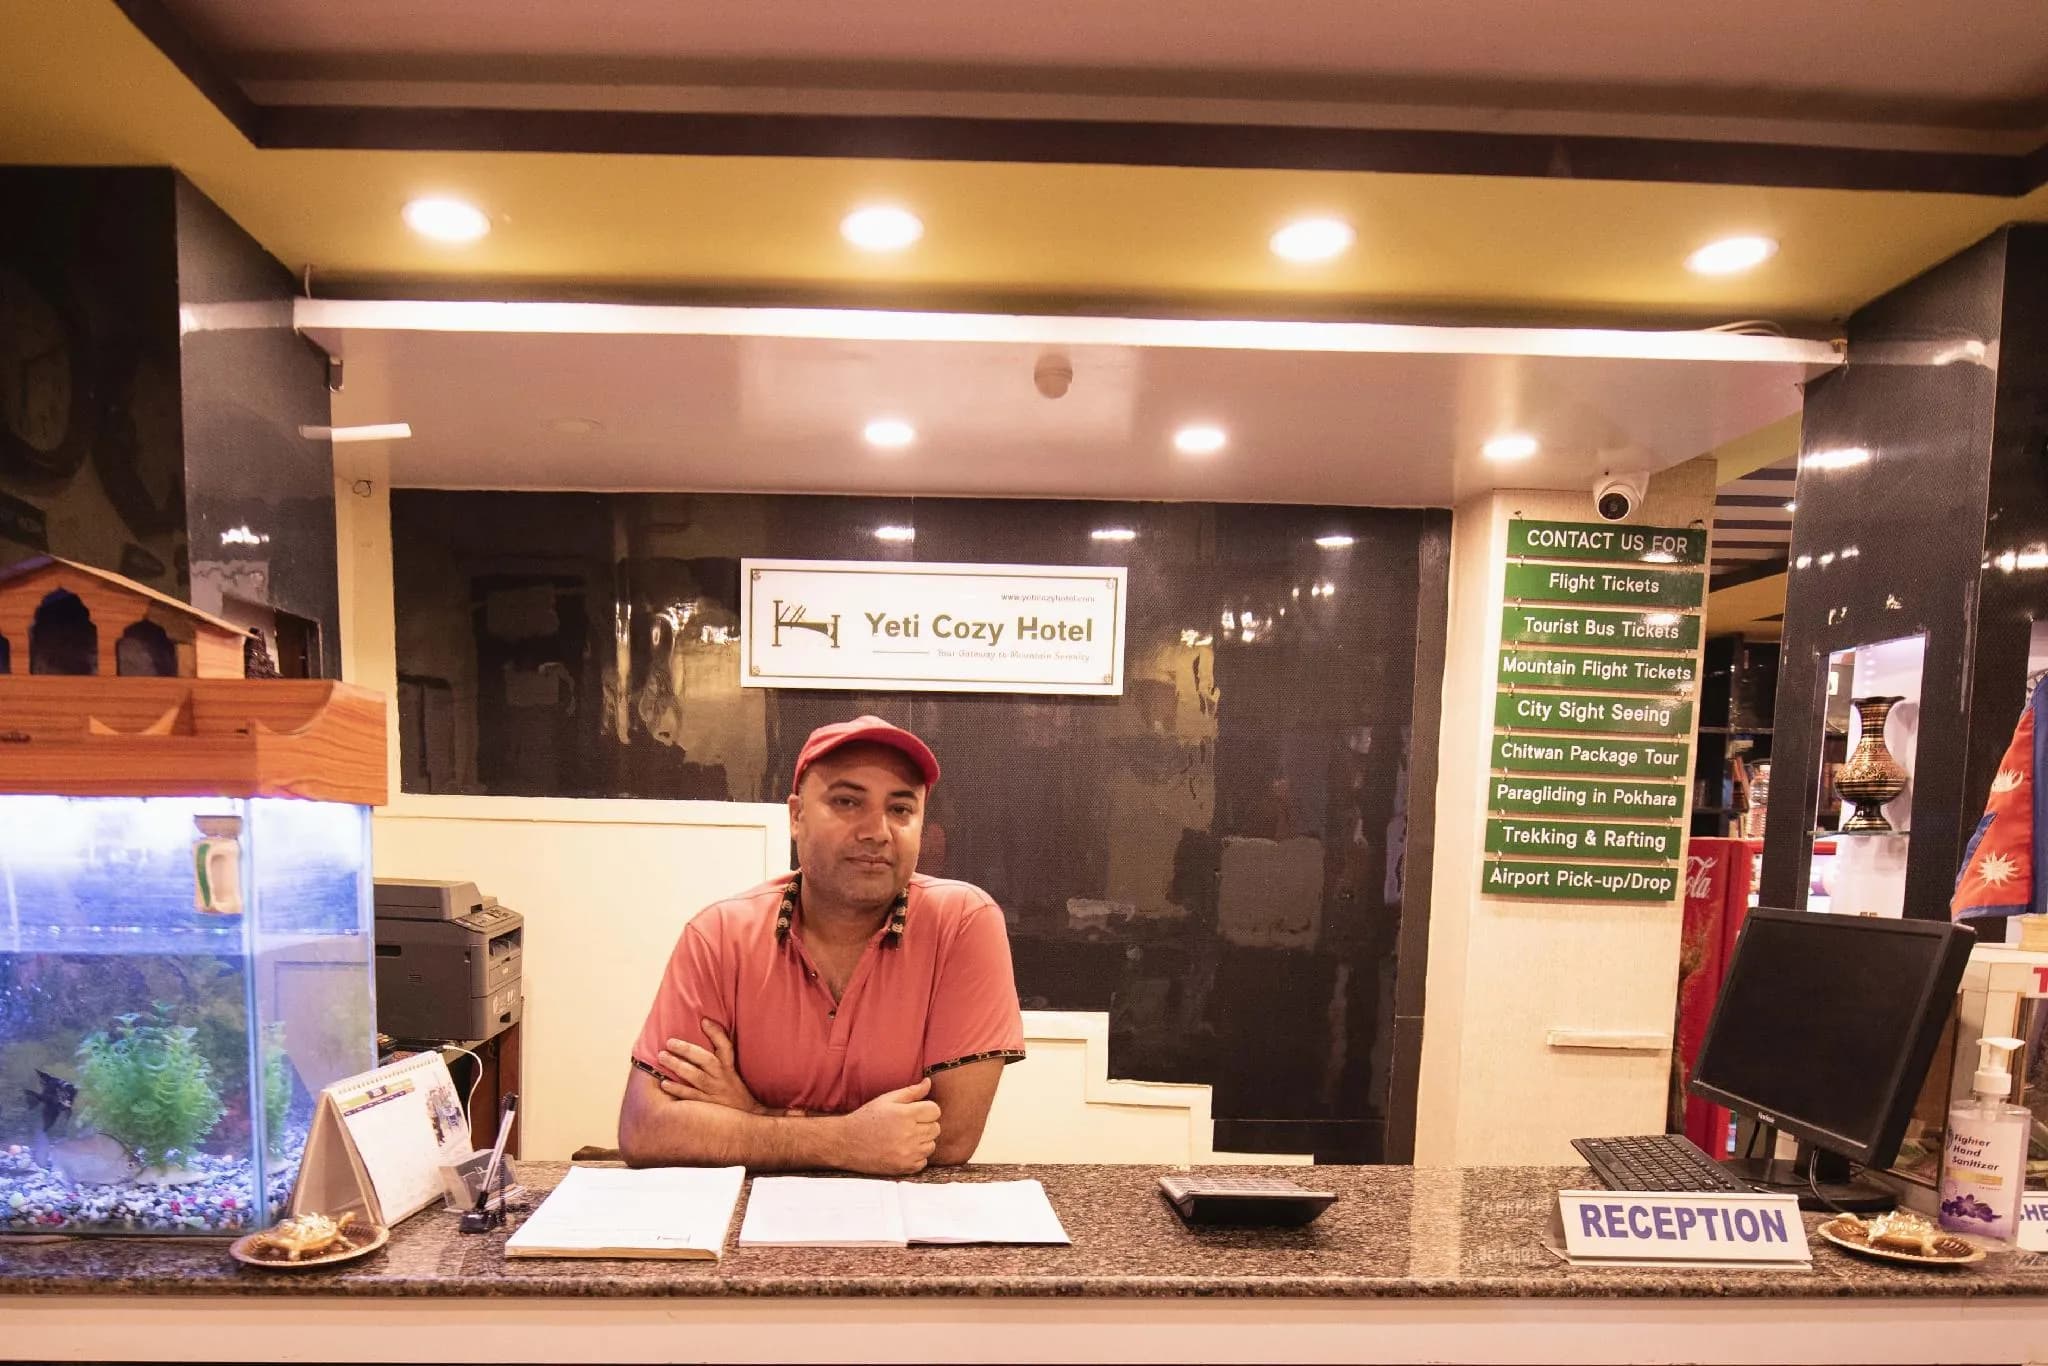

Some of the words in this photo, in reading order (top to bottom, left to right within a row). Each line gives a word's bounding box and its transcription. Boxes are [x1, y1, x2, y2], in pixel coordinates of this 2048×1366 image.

[1527, 529, 1614, 550] CONTACT
[1621, 533, 1644, 551] US
[1652, 535, 1688, 554] FOR
[1549, 572, 1595, 594] Flight
[1602, 575, 1660, 594] Tickets
[864, 612, 919, 638] Yeti
[931, 616, 1005, 646] Cozy
[1017, 616, 1093, 642] Hotel
[1524, 616, 1578, 635] Tourist
[1585, 619, 1615, 637] Bus
[1621, 621, 1679, 639] Tickets
[1503, 656, 1576, 676] Mountain
[1582, 659, 1628, 680] Flight
[1635, 662, 1691, 681] Tickets
[1517, 700, 1552, 722] City
[1558, 701, 1604, 723] Sight
[1611, 703, 1670, 727] Seeing
[1501, 742, 1564, 760] Chitwan
[1570, 745, 1637, 767] Package
[1645, 748, 1679, 765] Tour
[1497, 784, 1587, 806] Paragliding
[1593, 788, 1607, 803] in
[1613, 788, 1677, 807] Pokhara
[1502, 826, 1577, 849] Trekking
[1584, 829, 1597, 847] &
[1604, 830, 1666, 852] Rafting
[1489, 867, 1549, 888] Airport
[1556, 869, 1672, 893] Pick-up/Drop
[1952, 1155, 2000, 1171] Sanitizer
[1953, 1145, 1982, 1157] Hand
[1578, 1203, 1788, 1243] RECEPTION
